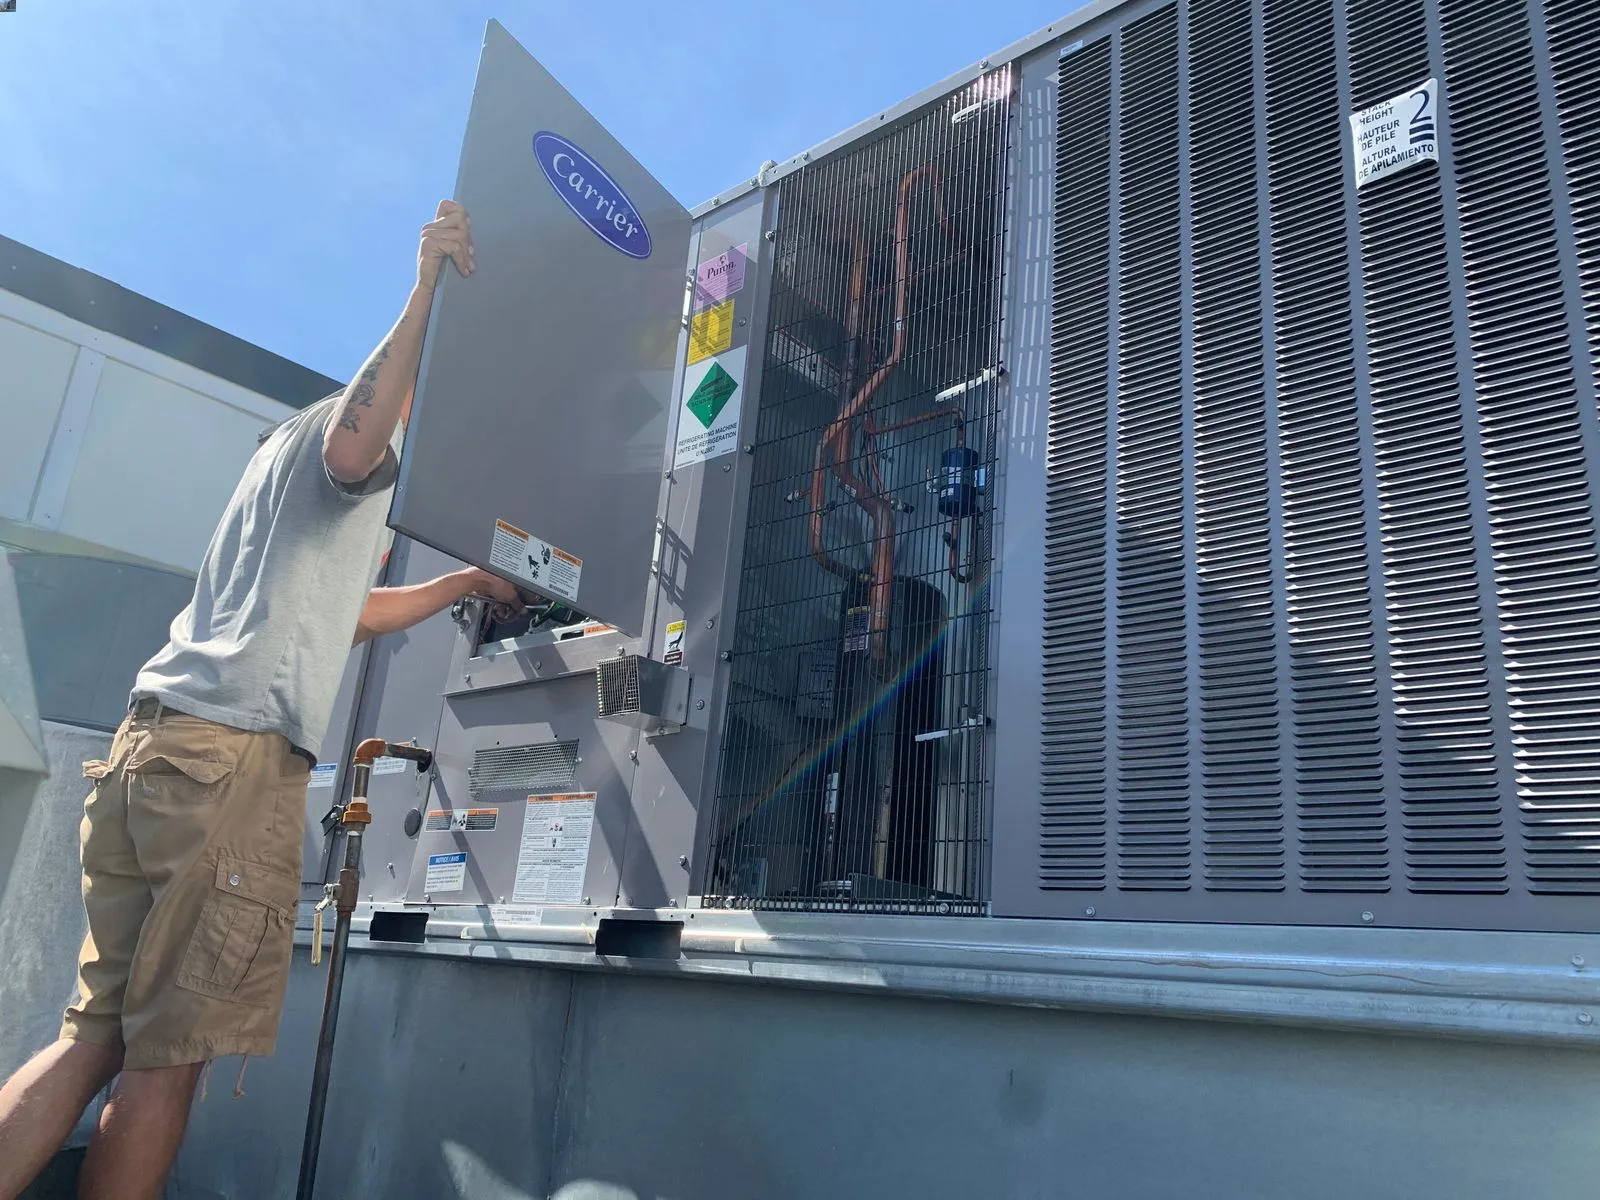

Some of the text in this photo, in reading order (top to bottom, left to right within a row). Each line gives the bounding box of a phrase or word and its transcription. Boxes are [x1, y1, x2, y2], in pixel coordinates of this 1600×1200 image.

[1410, 89, 1432, 125] 2
[1361, 130, 1396, 152] DE PILE
[1362, 145, 1397, 167] ALTURA
[1371, 144, 1434, 174] APILAMIENTO
[553, 153, 638, 238] Carrier
[714, 422, 738, 435] MACHINE
